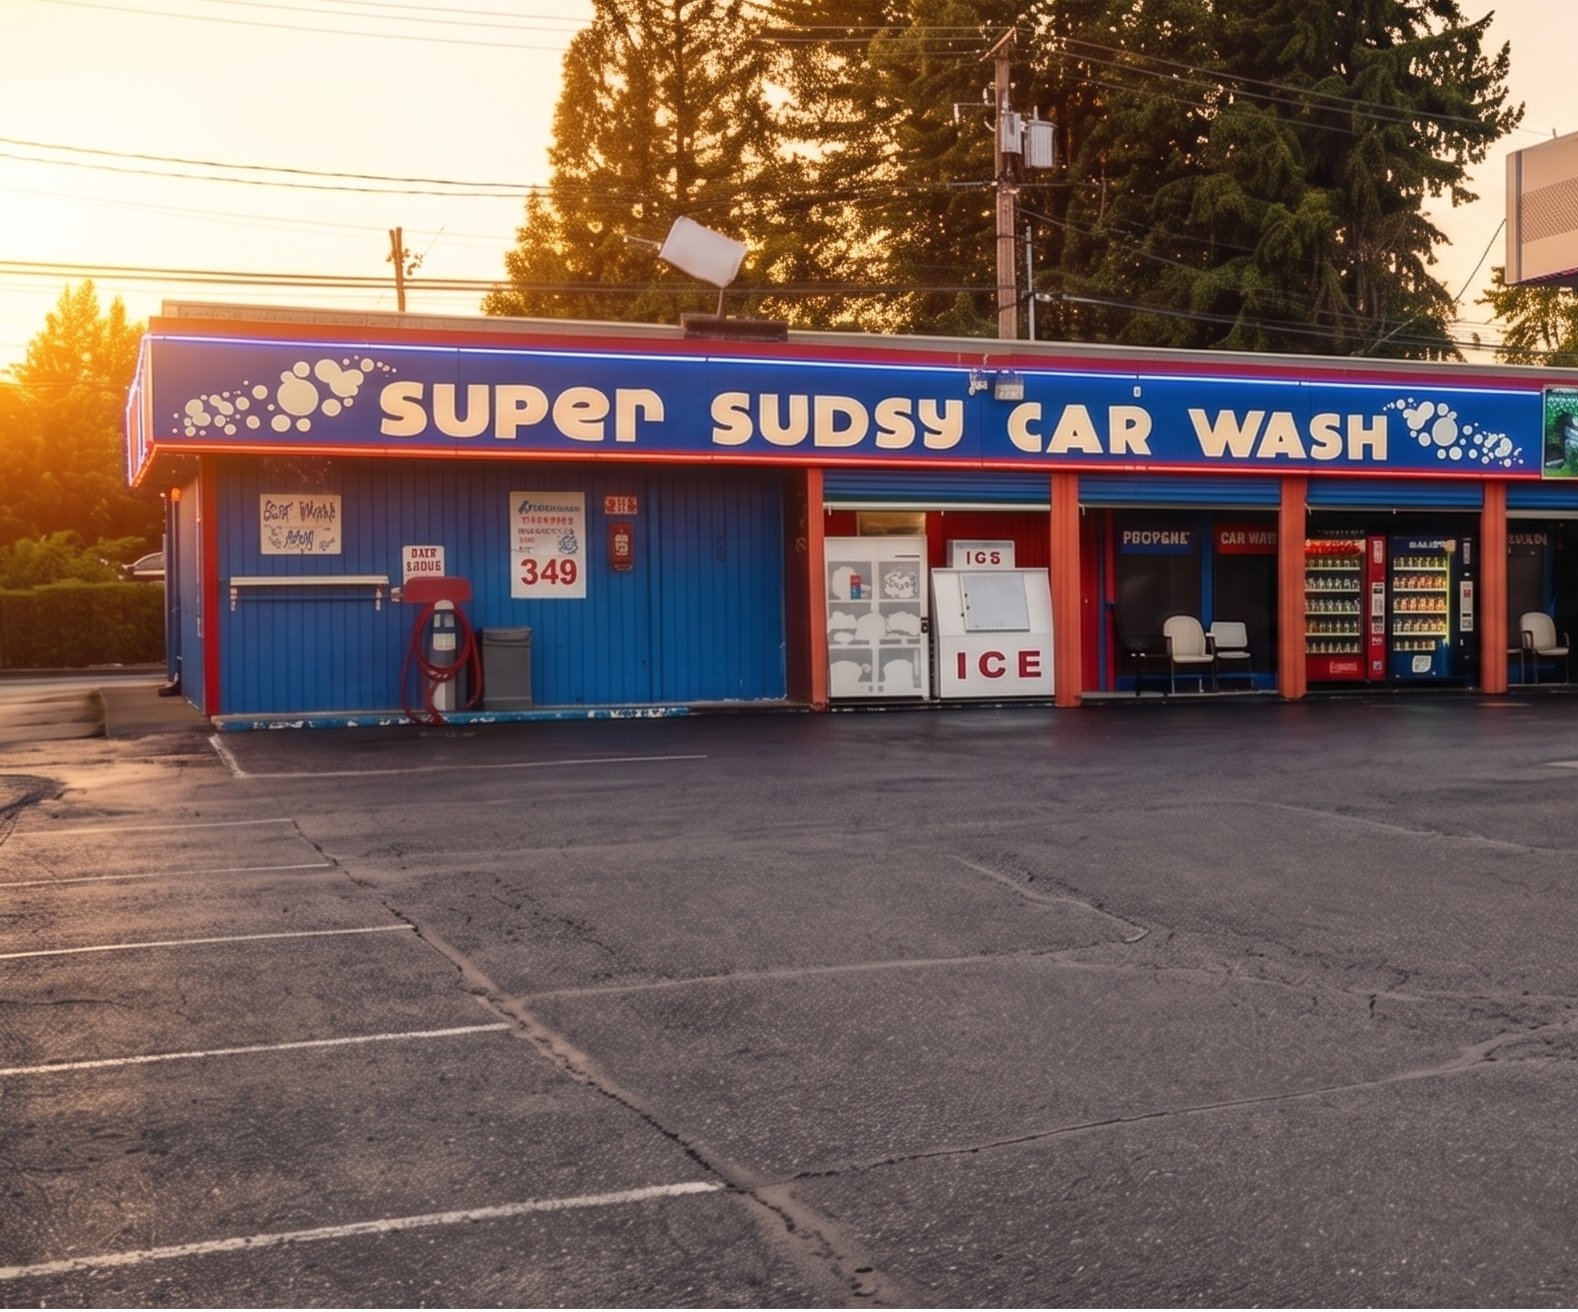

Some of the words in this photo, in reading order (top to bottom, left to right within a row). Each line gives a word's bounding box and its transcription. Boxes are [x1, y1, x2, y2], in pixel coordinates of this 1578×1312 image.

[710, 392, 964, 450] SUDSY
[1006, 402, 1153, 456] CAR
[1187, 408, 1389, 461] WASH
[520, 558, 578, 586] 349
[956, 650, 1042, 680] ICE
